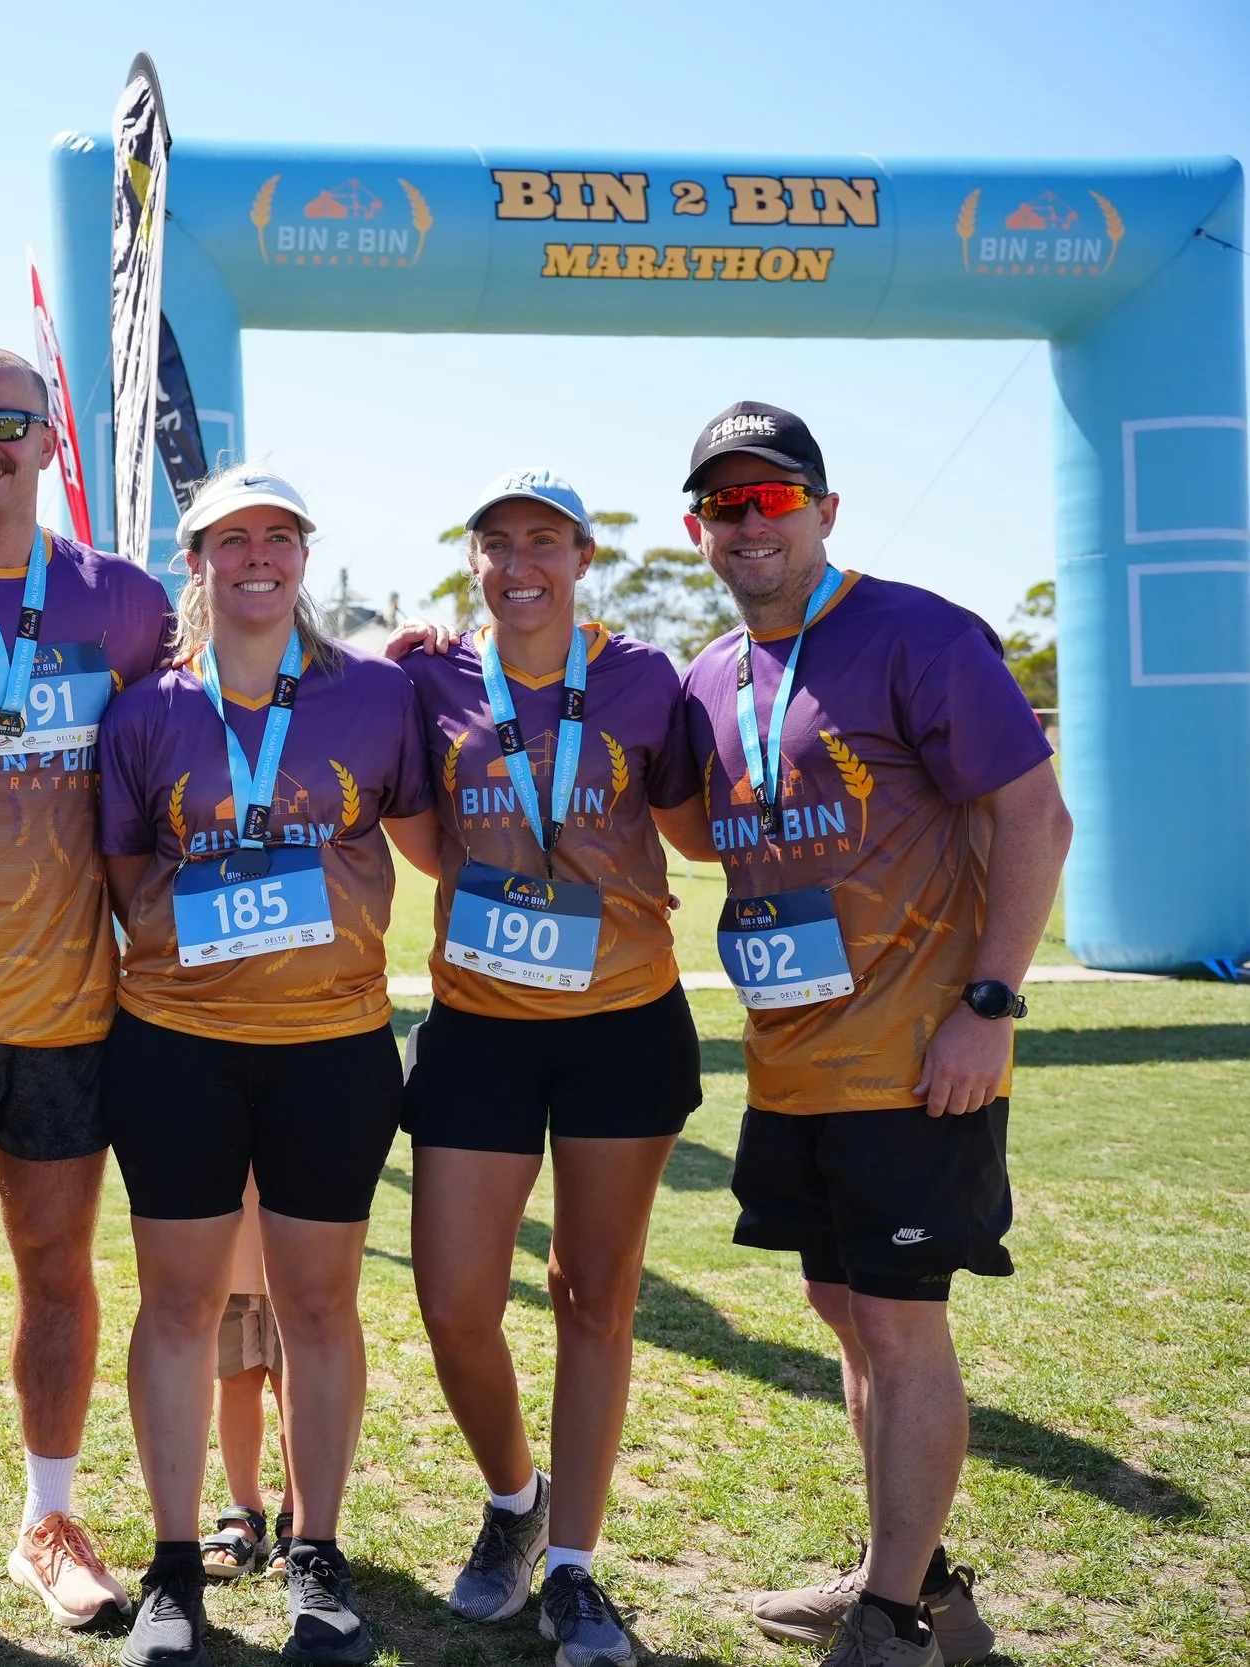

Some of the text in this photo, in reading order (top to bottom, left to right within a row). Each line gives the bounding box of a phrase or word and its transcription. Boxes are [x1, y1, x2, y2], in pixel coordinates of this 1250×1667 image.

[490, 168, 879, 227] BIN 2 BIN
[277, 226, 408, 254] BIN 2 BIN
[980, 237, 1102, 262] BIN 2 BIN
[541, 243, 834, 282] MARATHON
[31, 550, 45, 604] HALF-MARATHON
[18, 641, 31, 662] TEAM
[42, 663, 57, 672] BIN
[287, 653, 298, 674] TEAM
[571, 666, 582, 686] TEAM
[257, 712, 284, 803] HALF-MARATHON TEAM
[513, 756, 526, 777] TEAM
[559, 726, 575, 798] HALF-MARATHON
[461, 787, 605, 815] BIN IN
[556, 798, 566, 821] TEAM
[463, 816, 605, 830] MARATON
[712, 801, 846, 851] BIN BIN
[283, 823, 335, 847] BIN
[226, 871, 241, 880] BIN
[212, 881, 288, 934] 185
[508, 891, 524, 902] BIN
[530, 897, 546, 906] BIN
[740, 917, 751, 926] BIN
[756, 915, 772, 925] BIN
[264, 936, 287, 945] DELTA
[485, 907, 559, 961] 190
[735, 934, 803, 982] 192
[522, 970, 545, 979] DELTA
[780, 991, 803, 999] DELTA
[897, 1227, 925, 1240] NIKE
